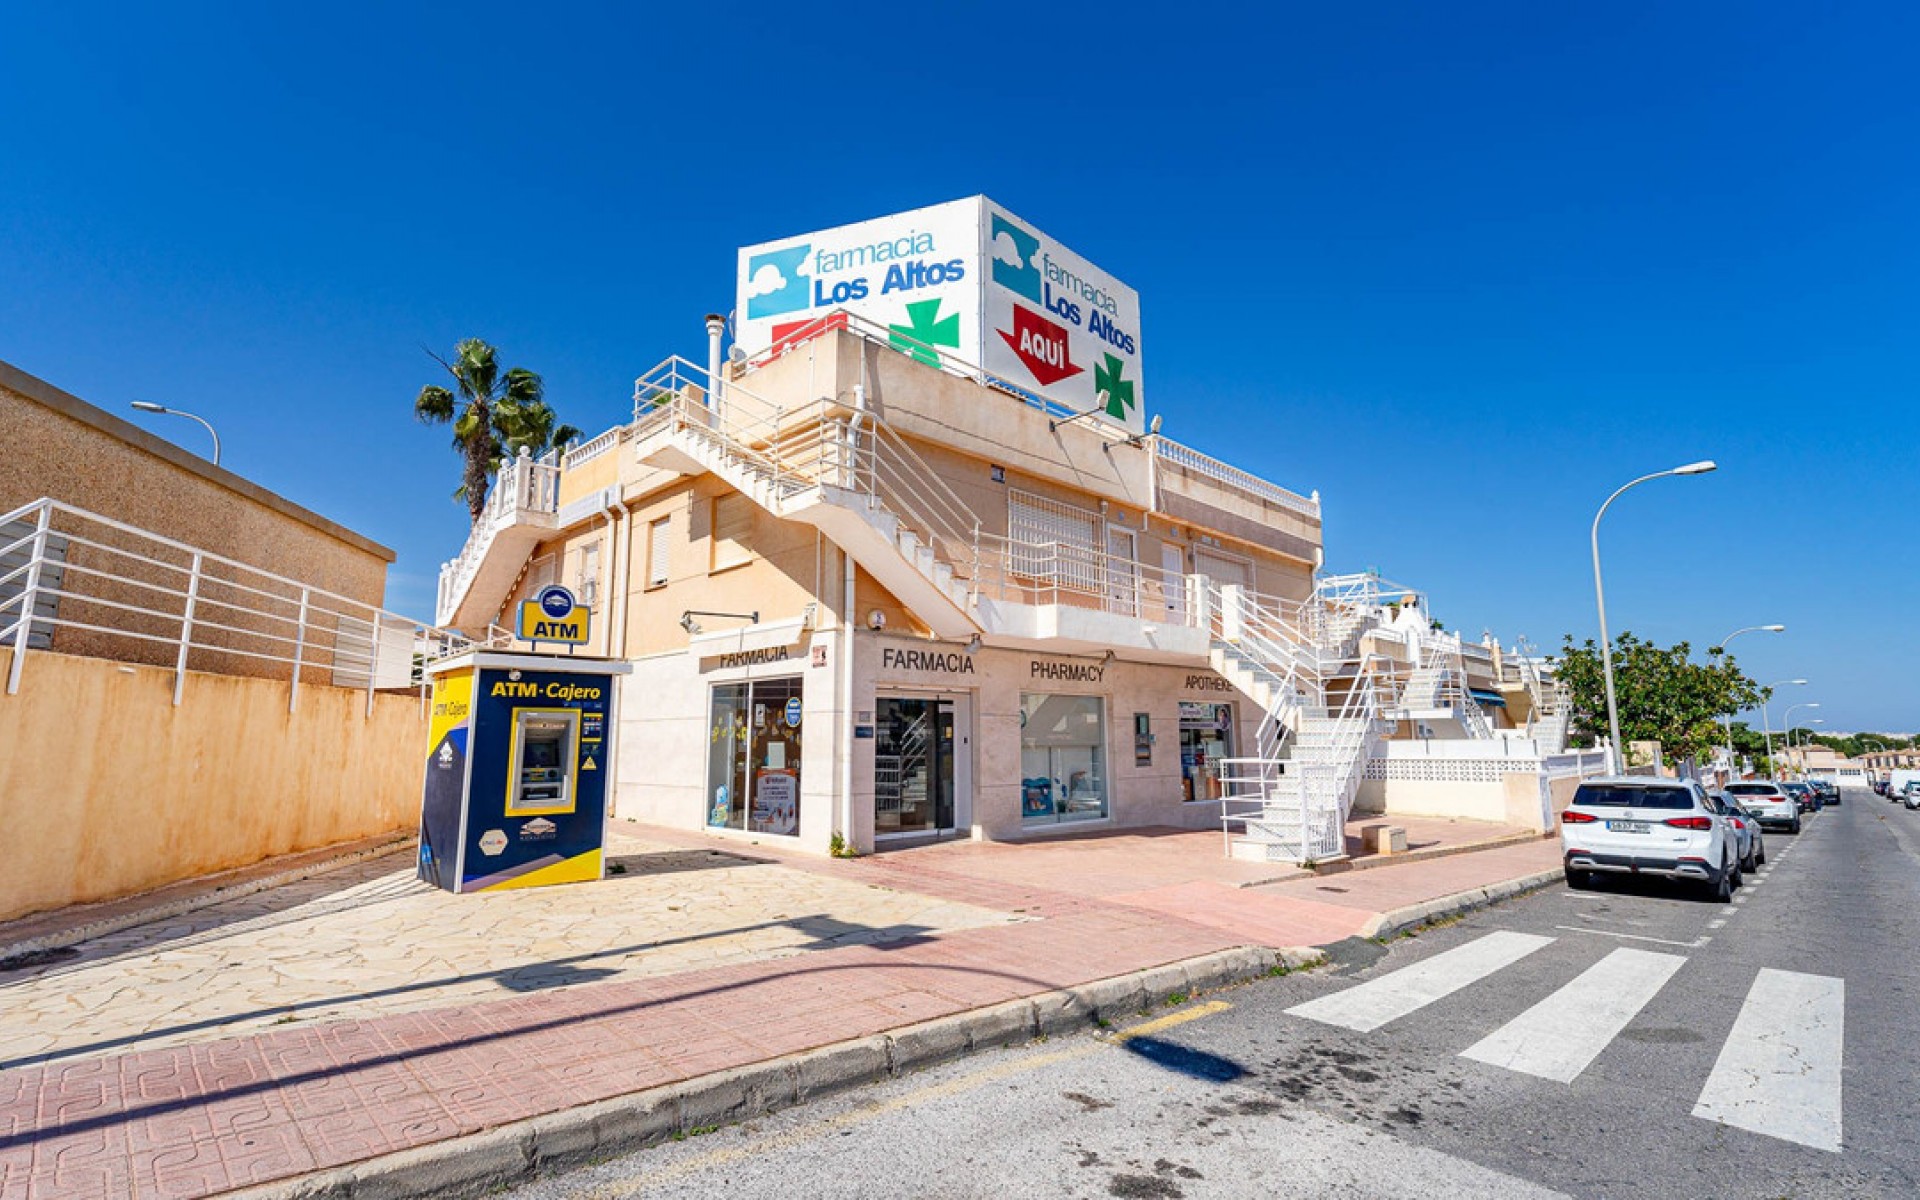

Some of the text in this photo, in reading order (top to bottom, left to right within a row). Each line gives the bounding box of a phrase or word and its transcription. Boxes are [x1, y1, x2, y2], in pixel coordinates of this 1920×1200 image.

[814, 229, 935, 274] farmacia
[814, 257, 965, 307] Los Altos
[1043, 252, 1119, 317] farmacia
[1044, 282, 1136, 355] Los Altos
[533, 621, 579, 639] ATM
[719, 645, 789, 669] FARMACIA
[883, 648, 974, 674] FARMACIA
[1031, 660, 1104, 683] PHARMACY
[1185, 675, 1233, 692] APOTHEKE
[491, 682, 601, 701] ATM Cajero
